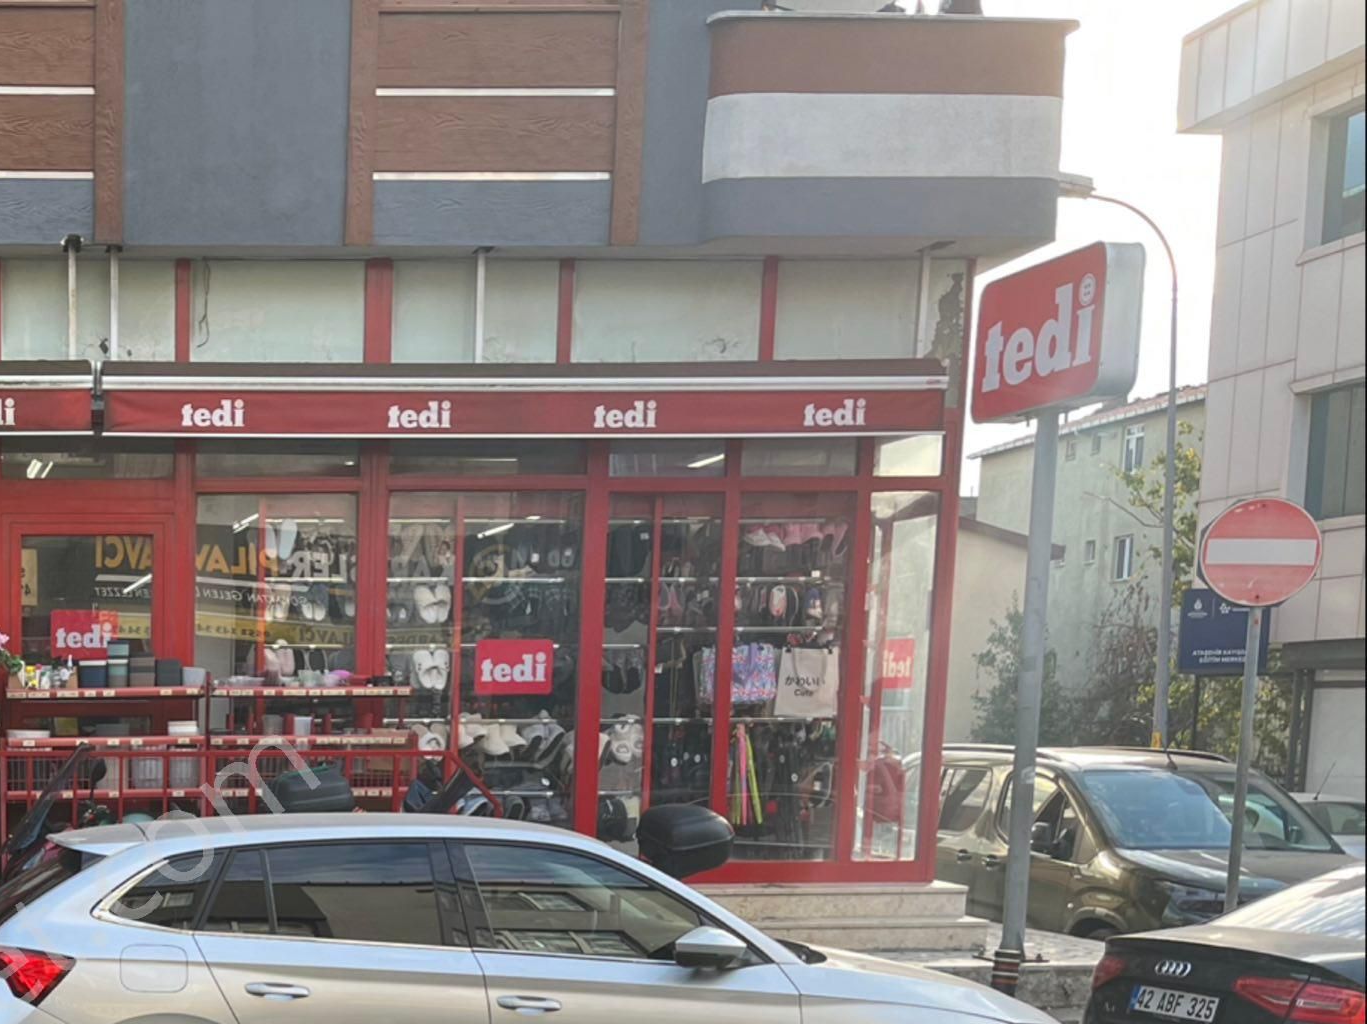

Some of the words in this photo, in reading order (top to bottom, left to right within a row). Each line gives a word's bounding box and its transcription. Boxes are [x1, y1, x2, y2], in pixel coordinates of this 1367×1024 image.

[981, 273, 1096, 393] tedi
[181, 399, 245, 427] tedi
[388, 400, 451, 428] tedi
[593, 400, 657, 428] tedi
[803, 398, 866, 426] tedi
[55, 622, 112, 649] tedi
[481, 651, 547, 683] tedi
[1137, 988, 1155, 1010] 42
[1156, 991, 1184, 1014] ABF
[1186, 997, 1216, 1020] 325
